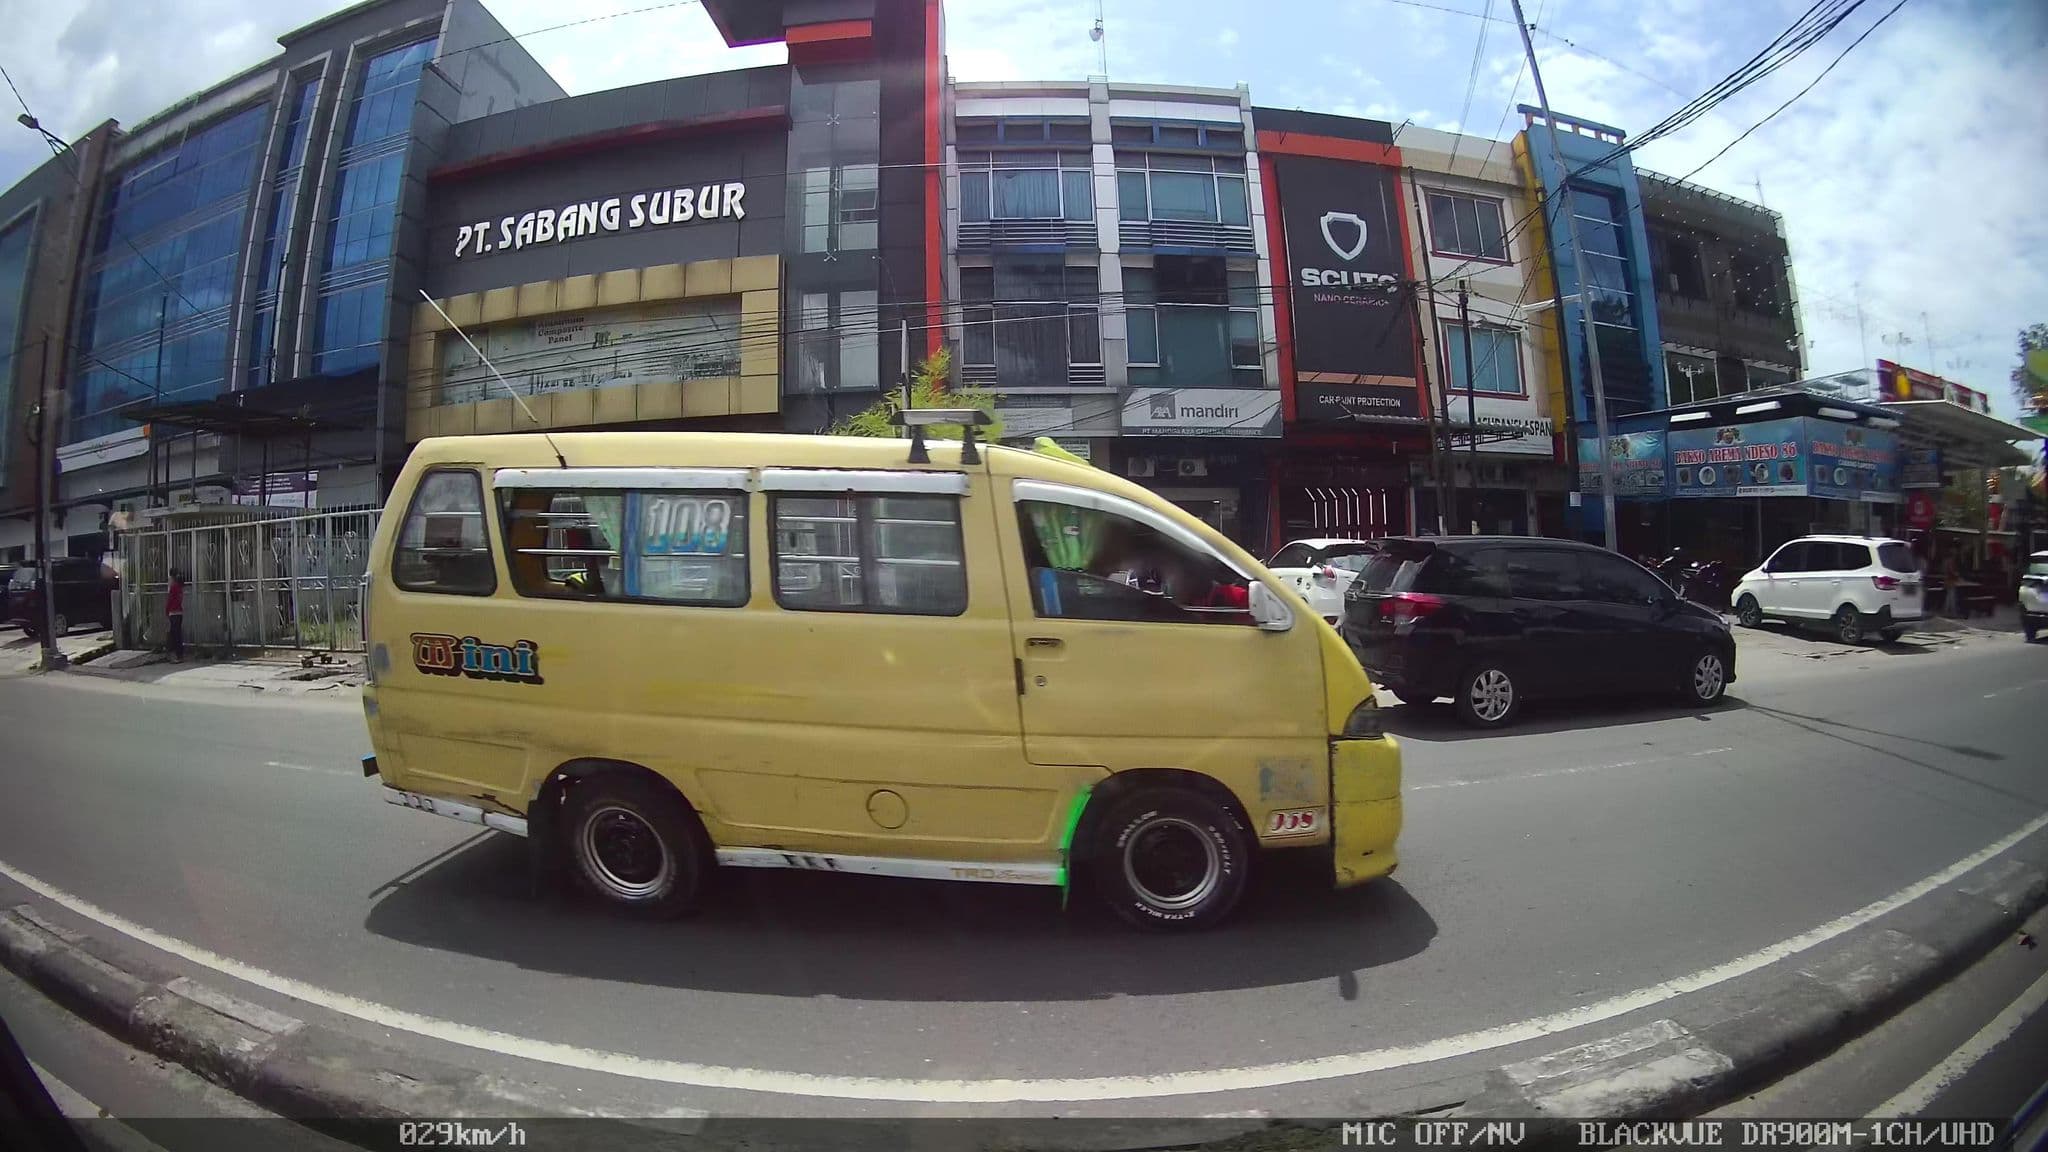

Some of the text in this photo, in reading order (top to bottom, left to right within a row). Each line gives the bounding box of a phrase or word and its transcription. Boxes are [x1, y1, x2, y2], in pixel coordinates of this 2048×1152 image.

[455, 182, 746, 257] PT. SABANG SUBUR
[548, 334, 573, 344] Panel
[1357, 397, 1401, 408] PROTECTION
[1150, 403, 1239, 420] AXA mandiri
